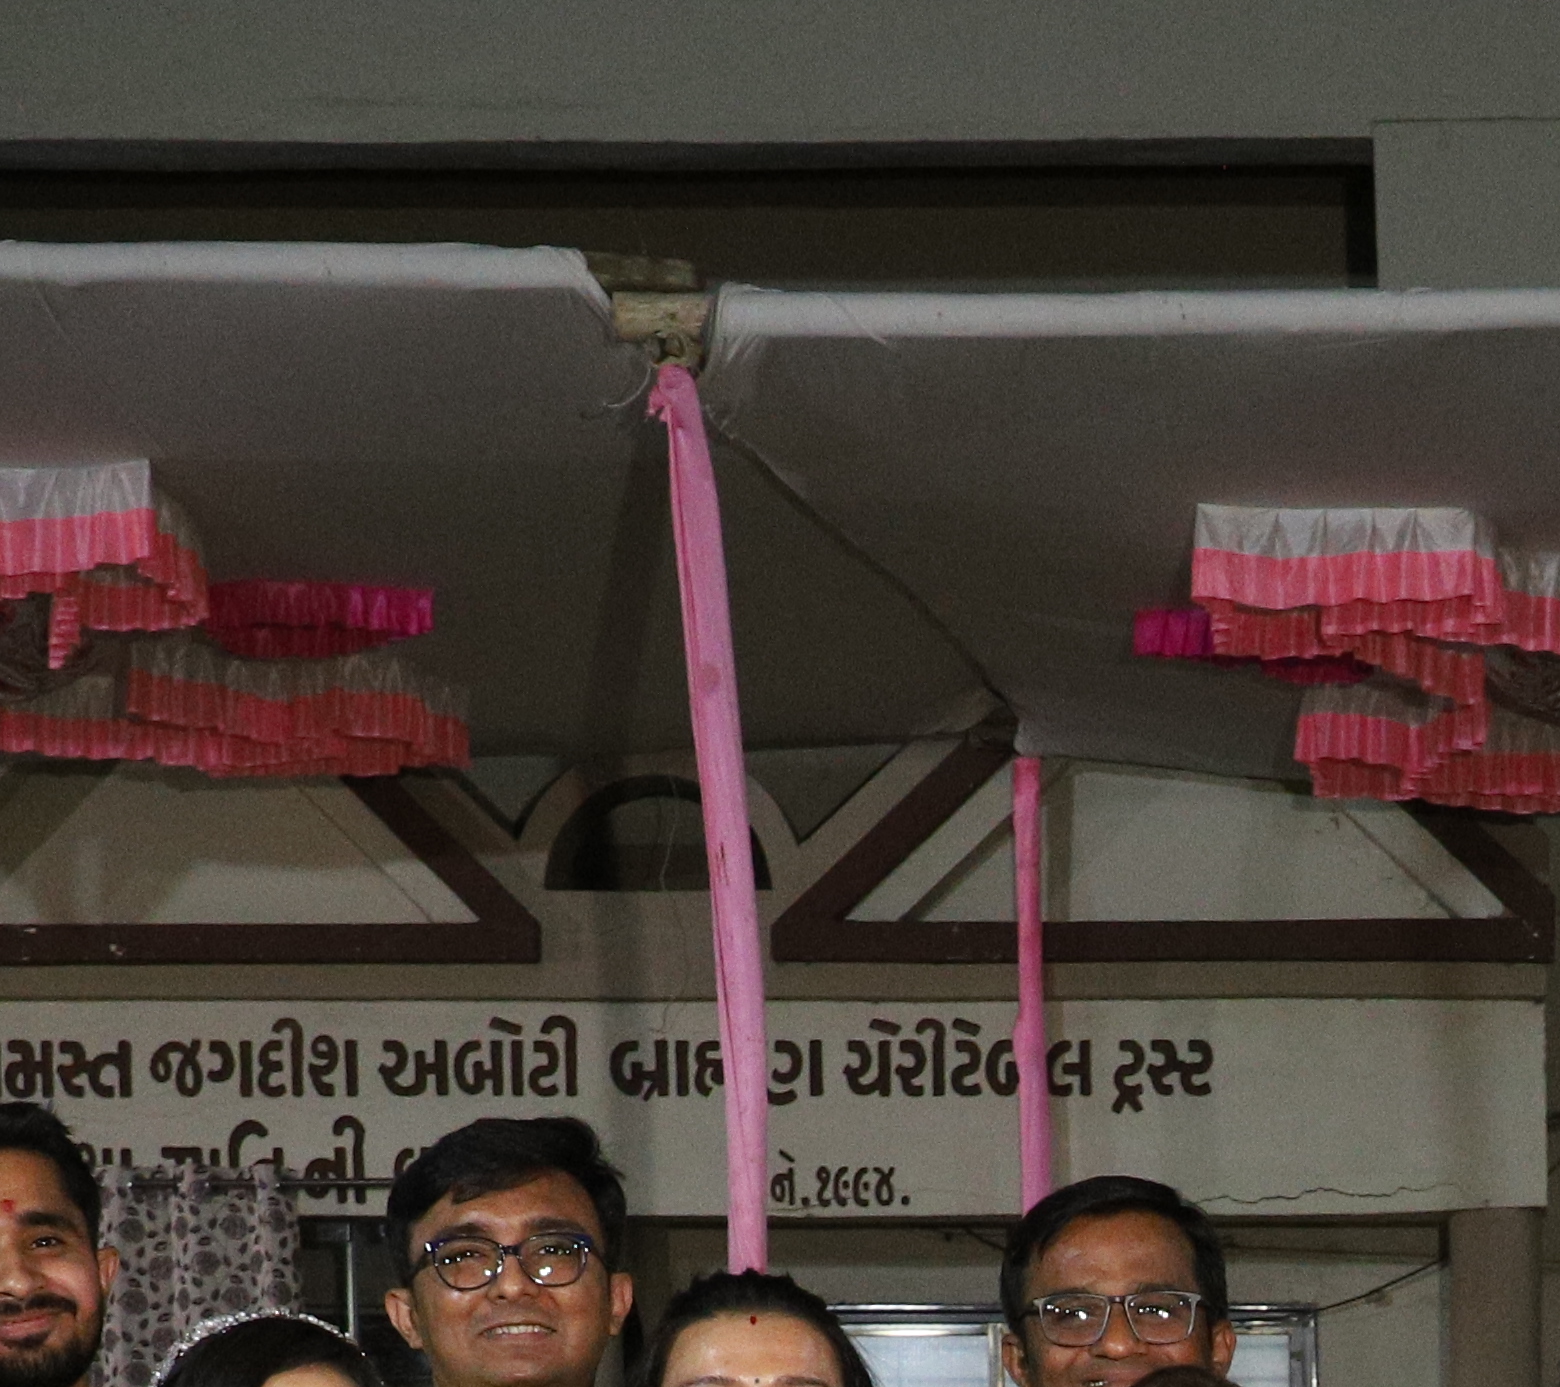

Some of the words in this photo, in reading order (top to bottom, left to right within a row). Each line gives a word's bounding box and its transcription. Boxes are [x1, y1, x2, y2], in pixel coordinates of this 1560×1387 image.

[149, 1017, 360, 1098] જગદીશ
[378, 1015, 579, 1098] અબોટી
[1111, 1039, 1214, 1114] ટ્રસ્ટ
